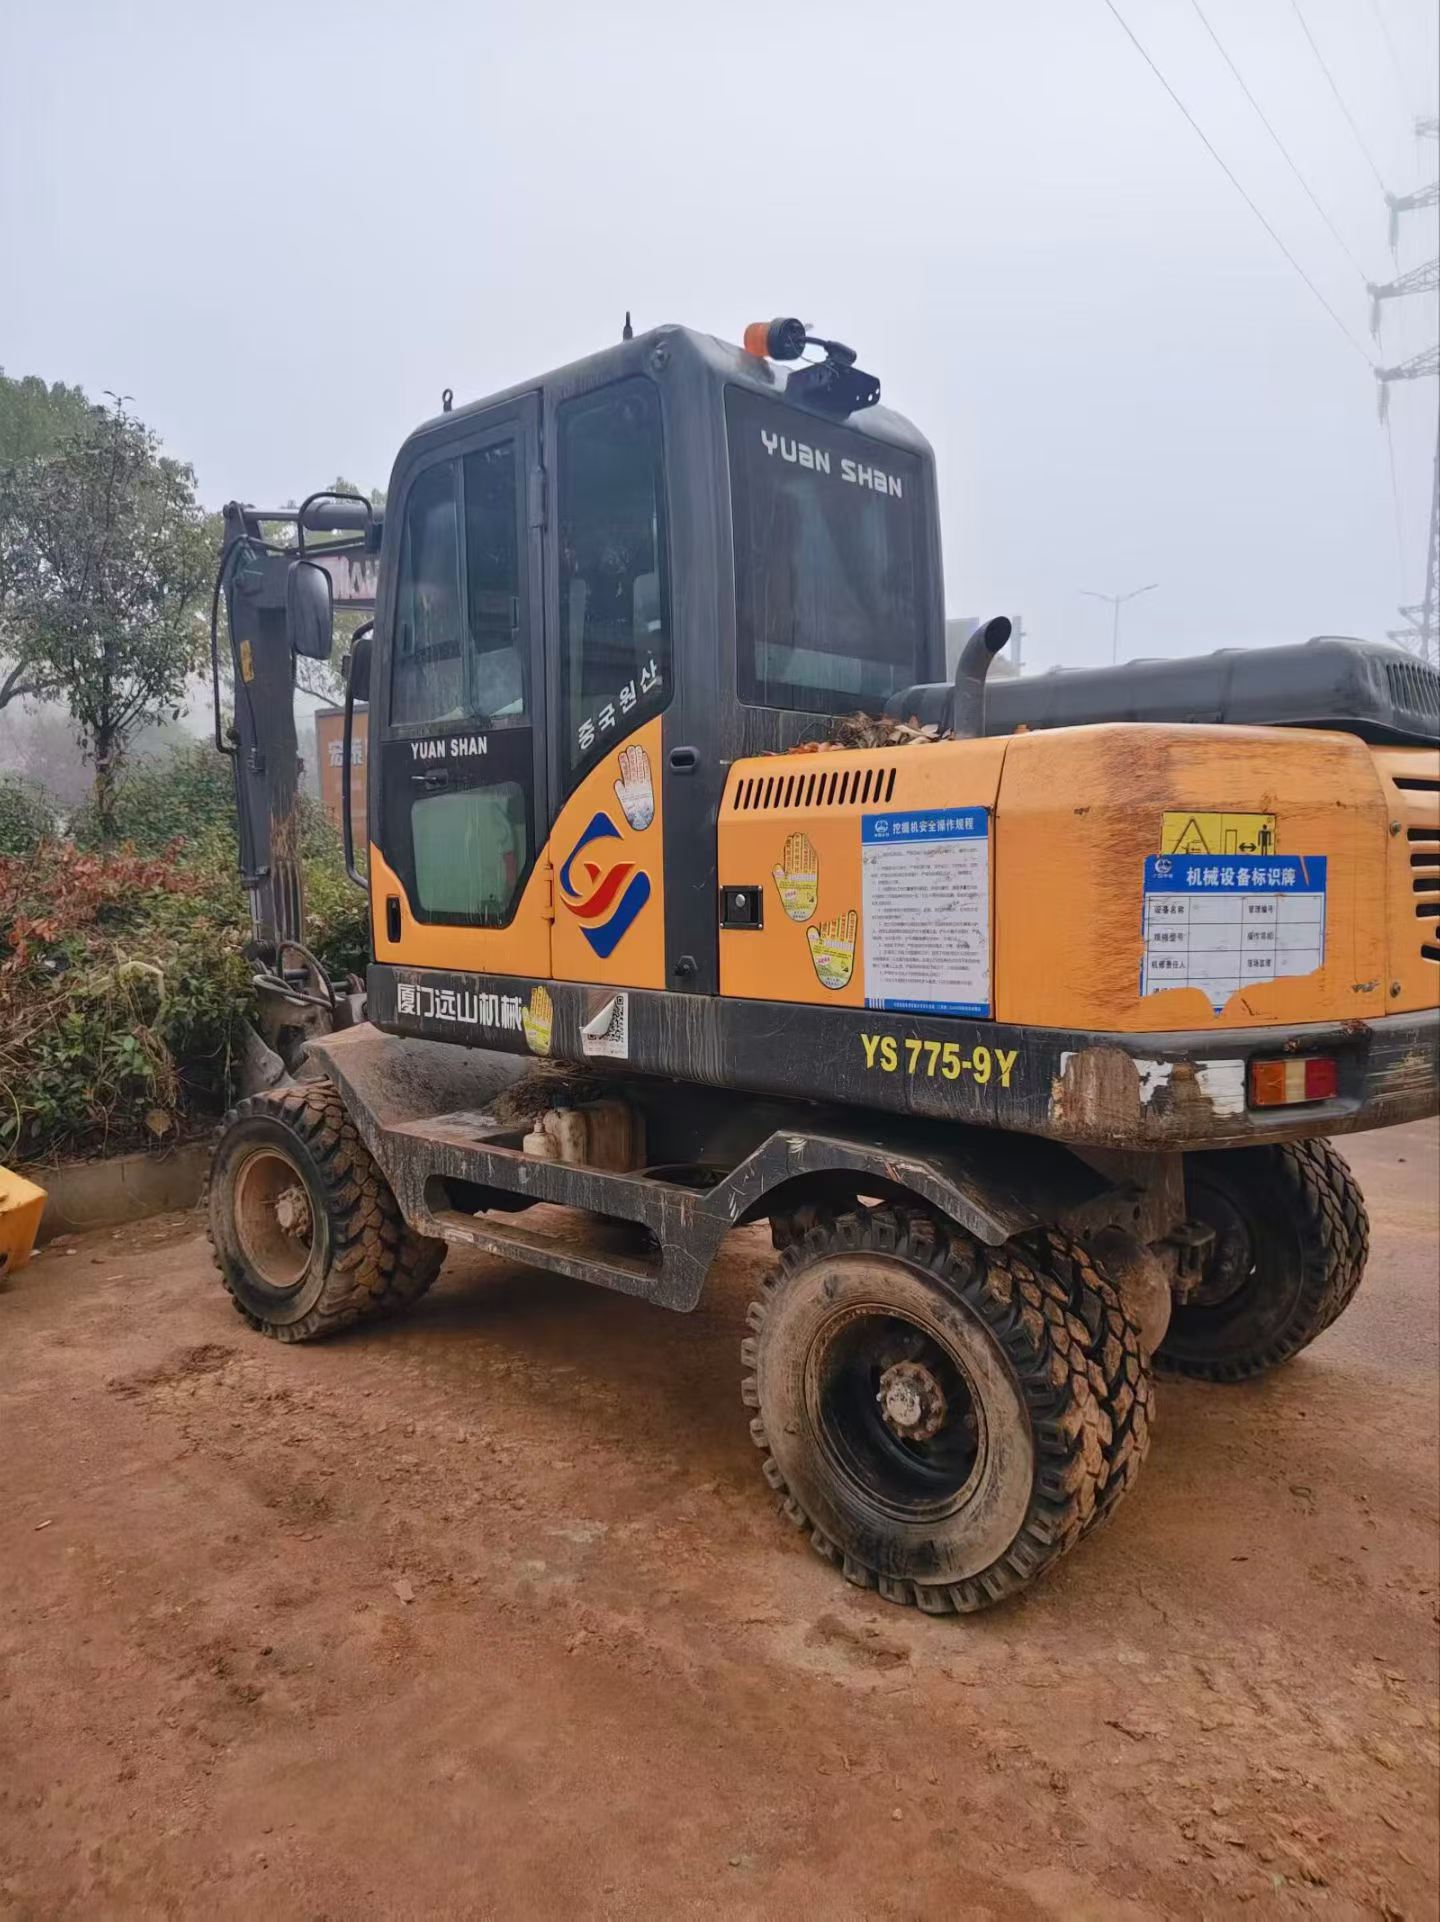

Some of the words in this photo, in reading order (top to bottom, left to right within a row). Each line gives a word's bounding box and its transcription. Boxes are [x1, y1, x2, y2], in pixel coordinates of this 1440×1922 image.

[578, 658, 658, 751] 중국원산
[411, 739, 446, 760] YUAN
[450, 736, 488, 758] SHAN
[892, 817, 975, 835] 挖掘机安全操作规程
[1186, 866, 1297, 887] 机械设备标识牌
[1153, 905, 1185, 914] 设备名称
[397, 983, 523, 1031] 厦门远山机械
